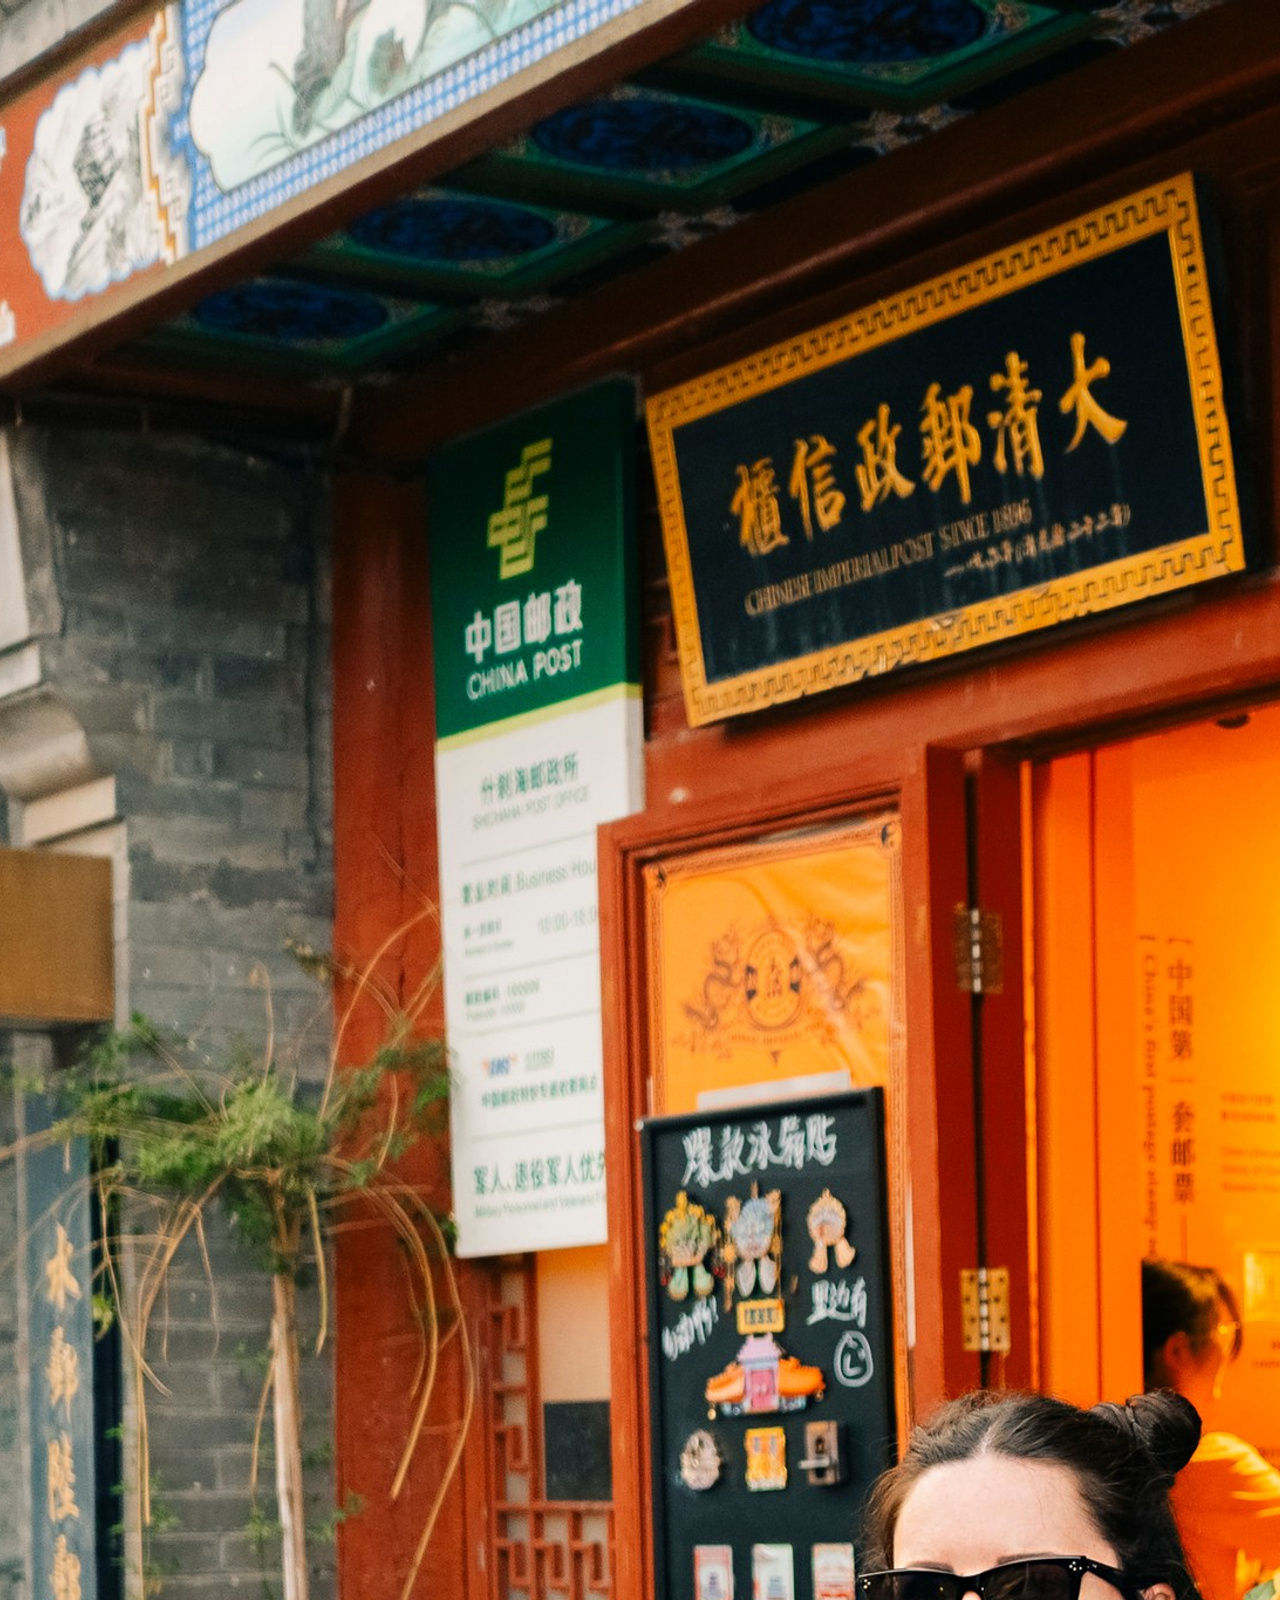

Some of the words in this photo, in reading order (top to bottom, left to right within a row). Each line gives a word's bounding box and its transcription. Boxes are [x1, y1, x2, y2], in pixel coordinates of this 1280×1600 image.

[744, 575, 812, 617] CHINESE
[813, 548, 890, 596] IMPERIAL
[890, 532, 935, 568] POST
[938, 516, 990, 551] SINCE
[465, 578, 583, 664] 中国邮政
[466, 658, 528, 701] CHINA
[532, 638, 583, 680] POST
[516, 865, 568, 892] Business
[571, 858, 597, 878] Hou
